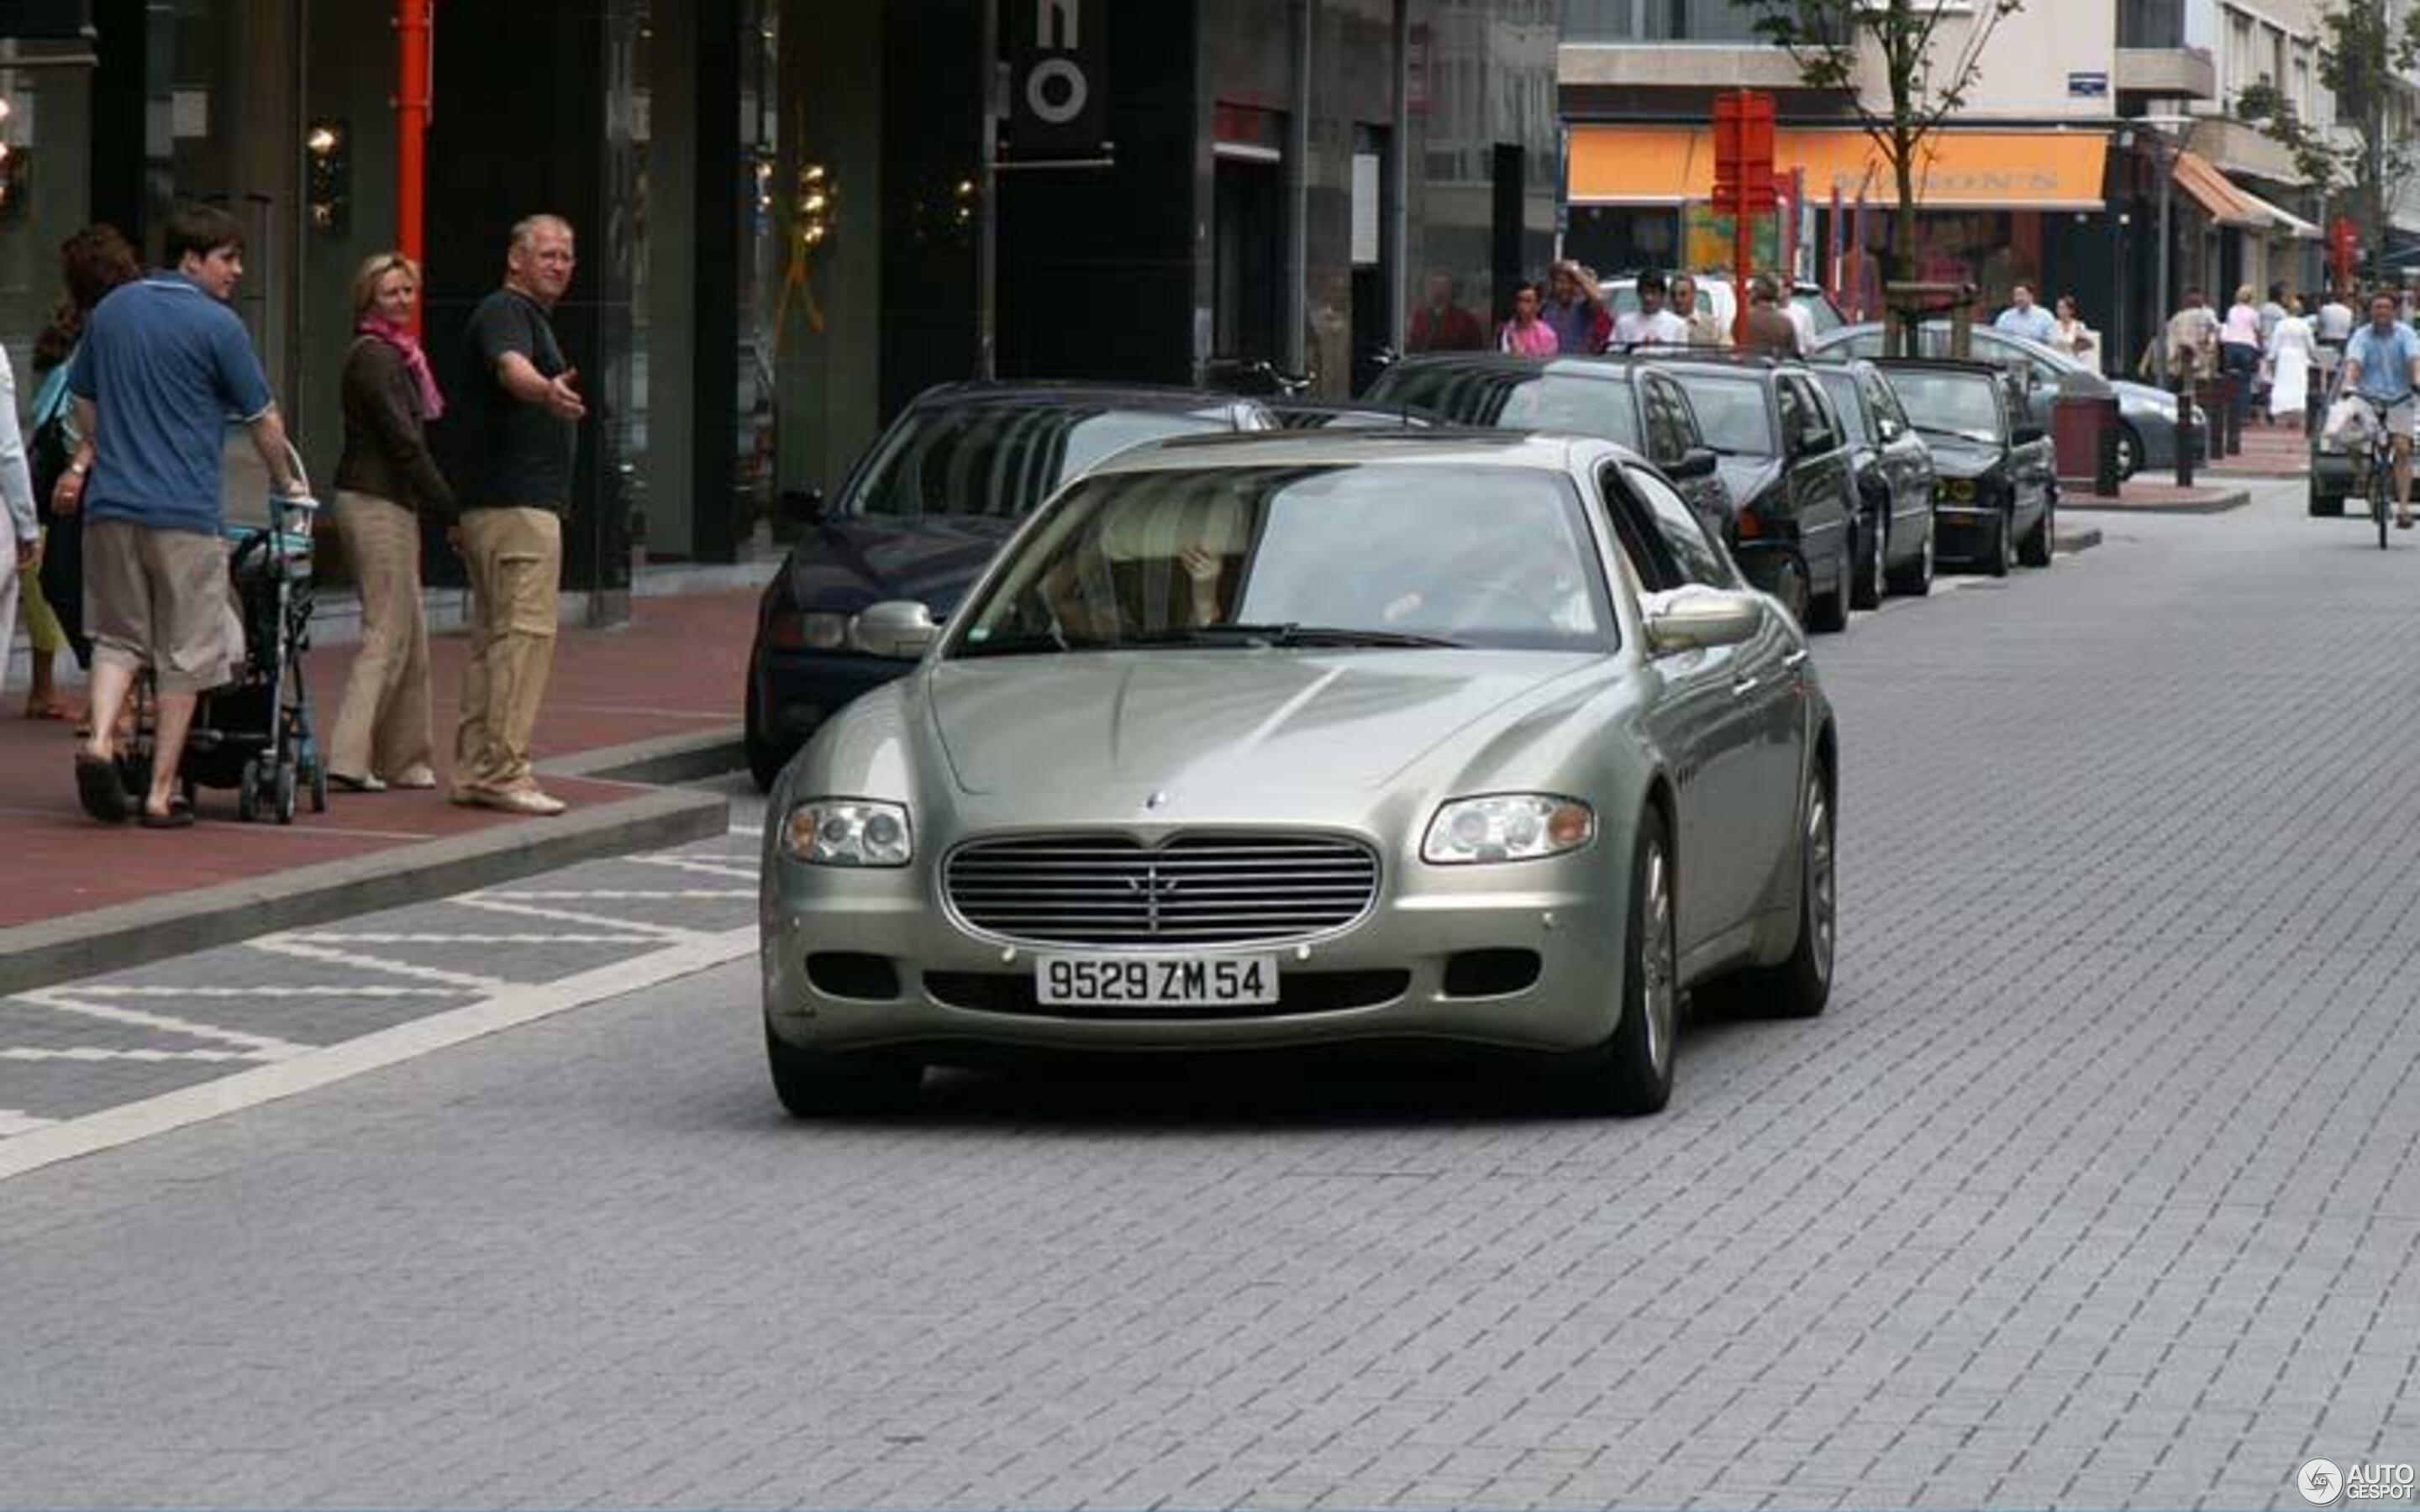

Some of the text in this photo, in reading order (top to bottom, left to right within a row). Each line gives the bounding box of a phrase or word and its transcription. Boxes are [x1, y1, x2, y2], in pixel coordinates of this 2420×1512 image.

[1050, 961, 1265, 999] 9529 ZM 54
